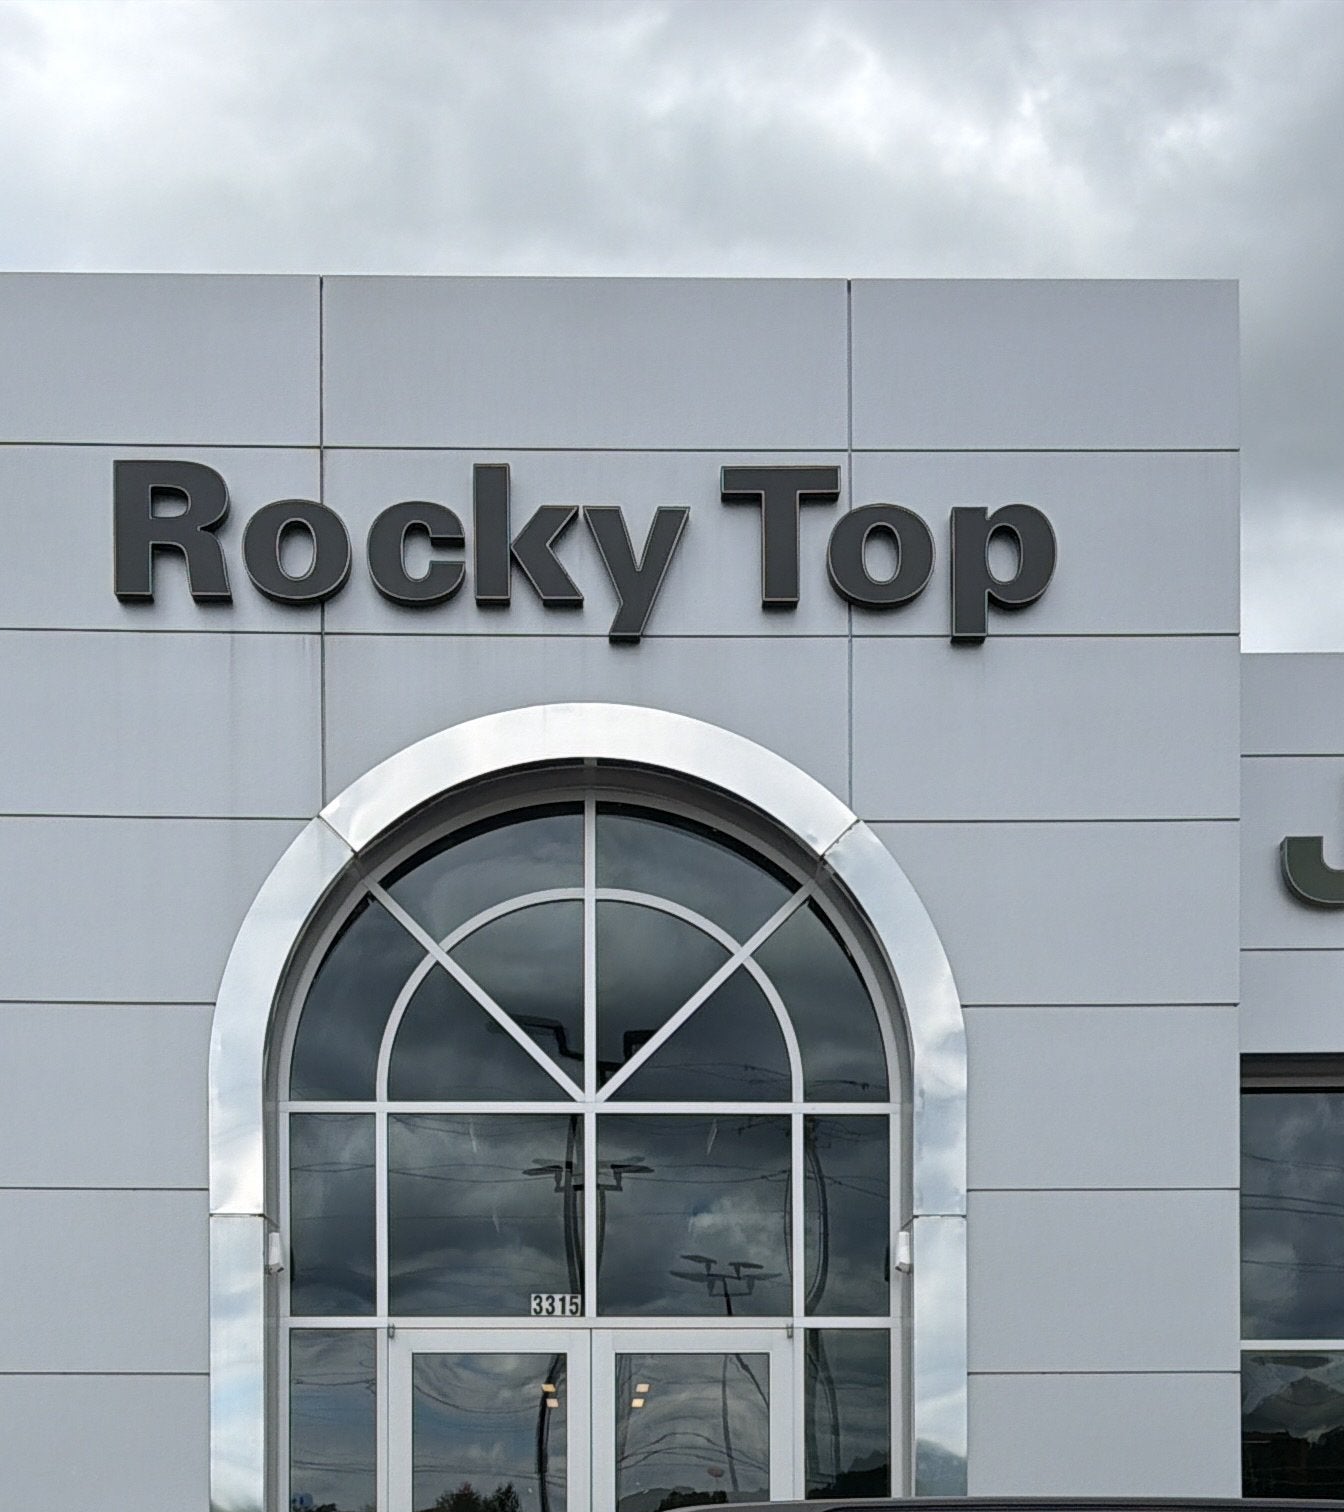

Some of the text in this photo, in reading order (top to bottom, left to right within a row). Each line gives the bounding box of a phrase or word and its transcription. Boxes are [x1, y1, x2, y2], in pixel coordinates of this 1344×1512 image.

[112, 459, 1058, 644] Rocky Top
[533, 1294, 579, 1315] 3315
